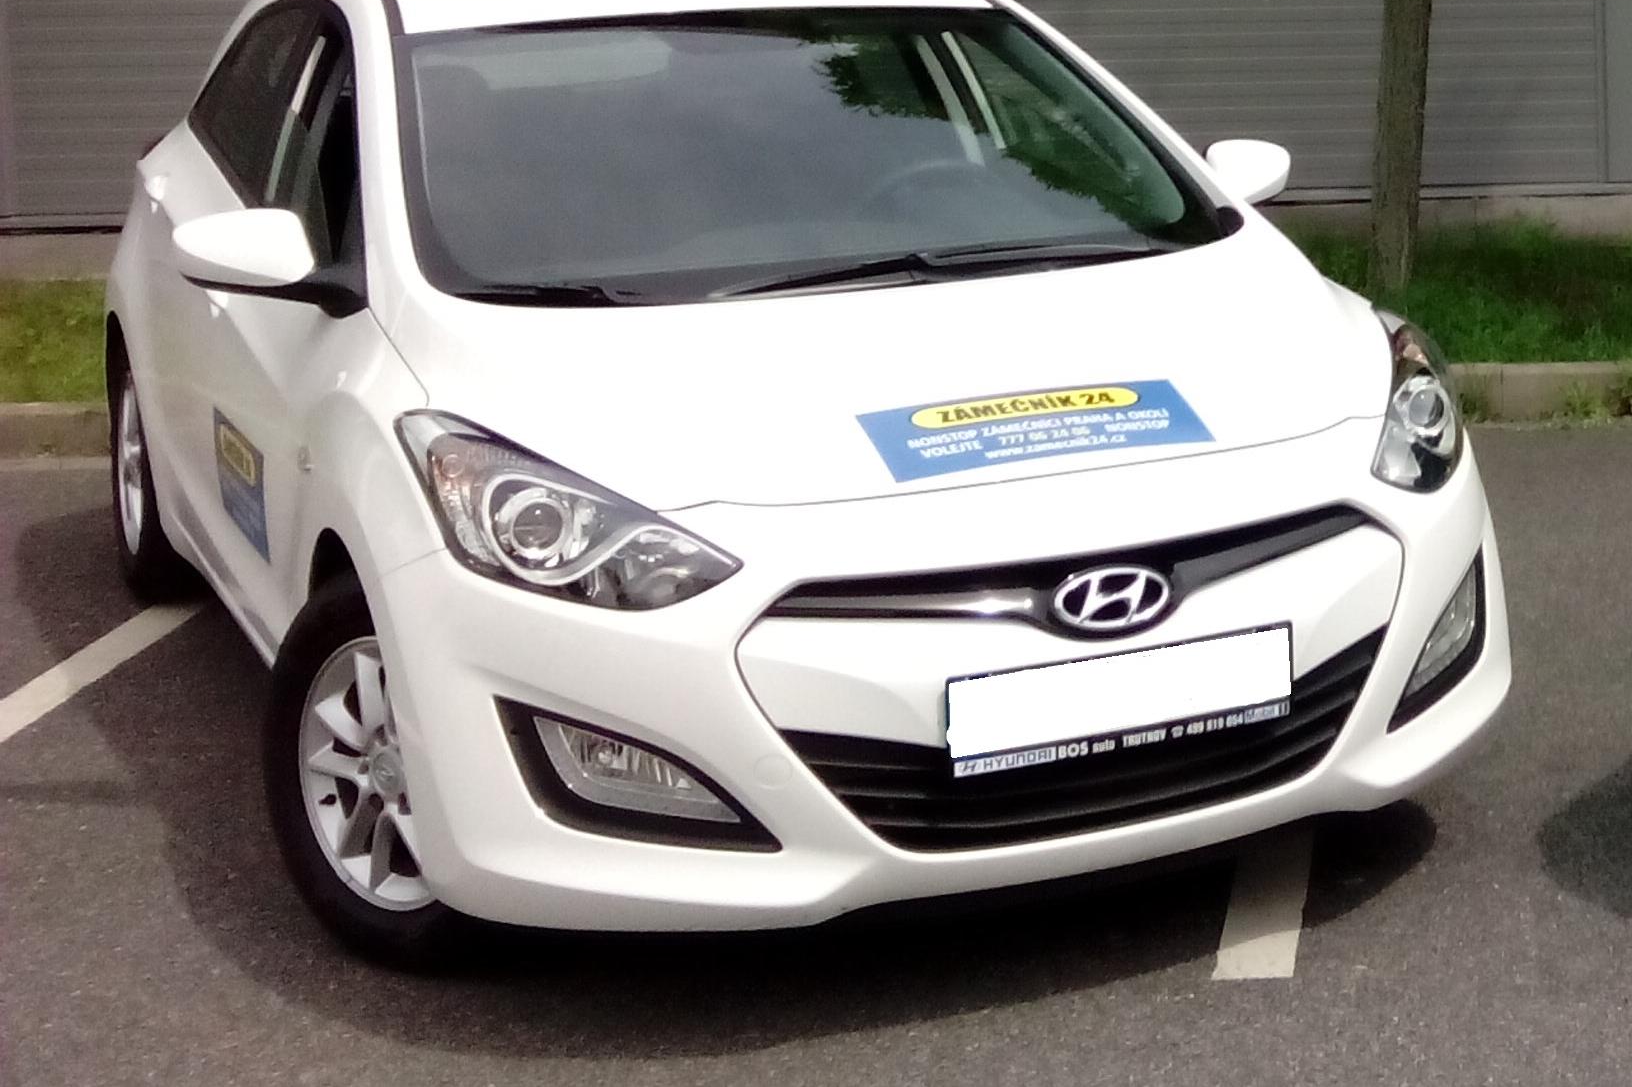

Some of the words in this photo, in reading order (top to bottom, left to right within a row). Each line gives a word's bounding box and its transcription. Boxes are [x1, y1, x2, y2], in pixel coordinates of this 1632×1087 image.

[936, 393, 1076, 423] ZÁMEČNÍK
[1079, 391, 1115, 405] 24
[907, 429, 977, 449] NONSTOP
[920, 440, 984, 459] VOLEJTE
[983, 748, 1053, 770] HYUNDAI
[1057, 741, 1089, 760] BOS
